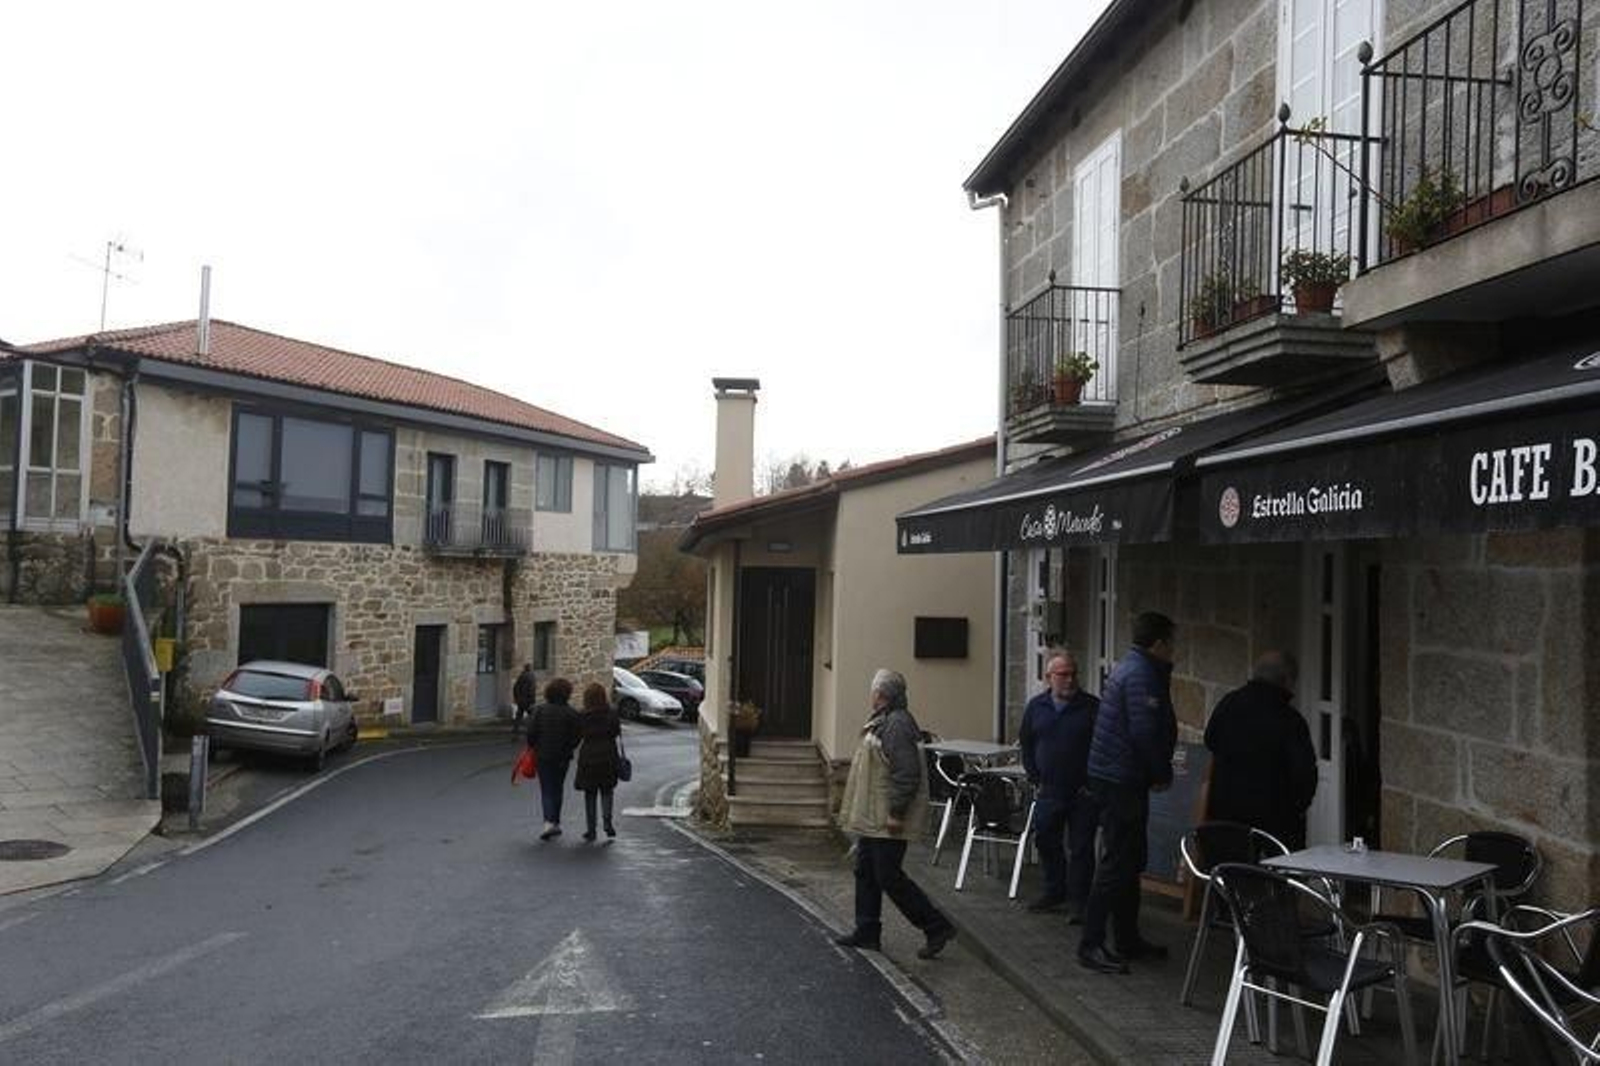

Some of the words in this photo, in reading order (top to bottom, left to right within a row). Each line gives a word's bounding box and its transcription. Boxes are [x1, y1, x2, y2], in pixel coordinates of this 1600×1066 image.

[1470, 443, 1552, 505] CAFE
[1569, 437, 1600, 497] B
[1252, 491, 1305, 518] Estrella
[1307, 483, 1362, 514] Galicia
